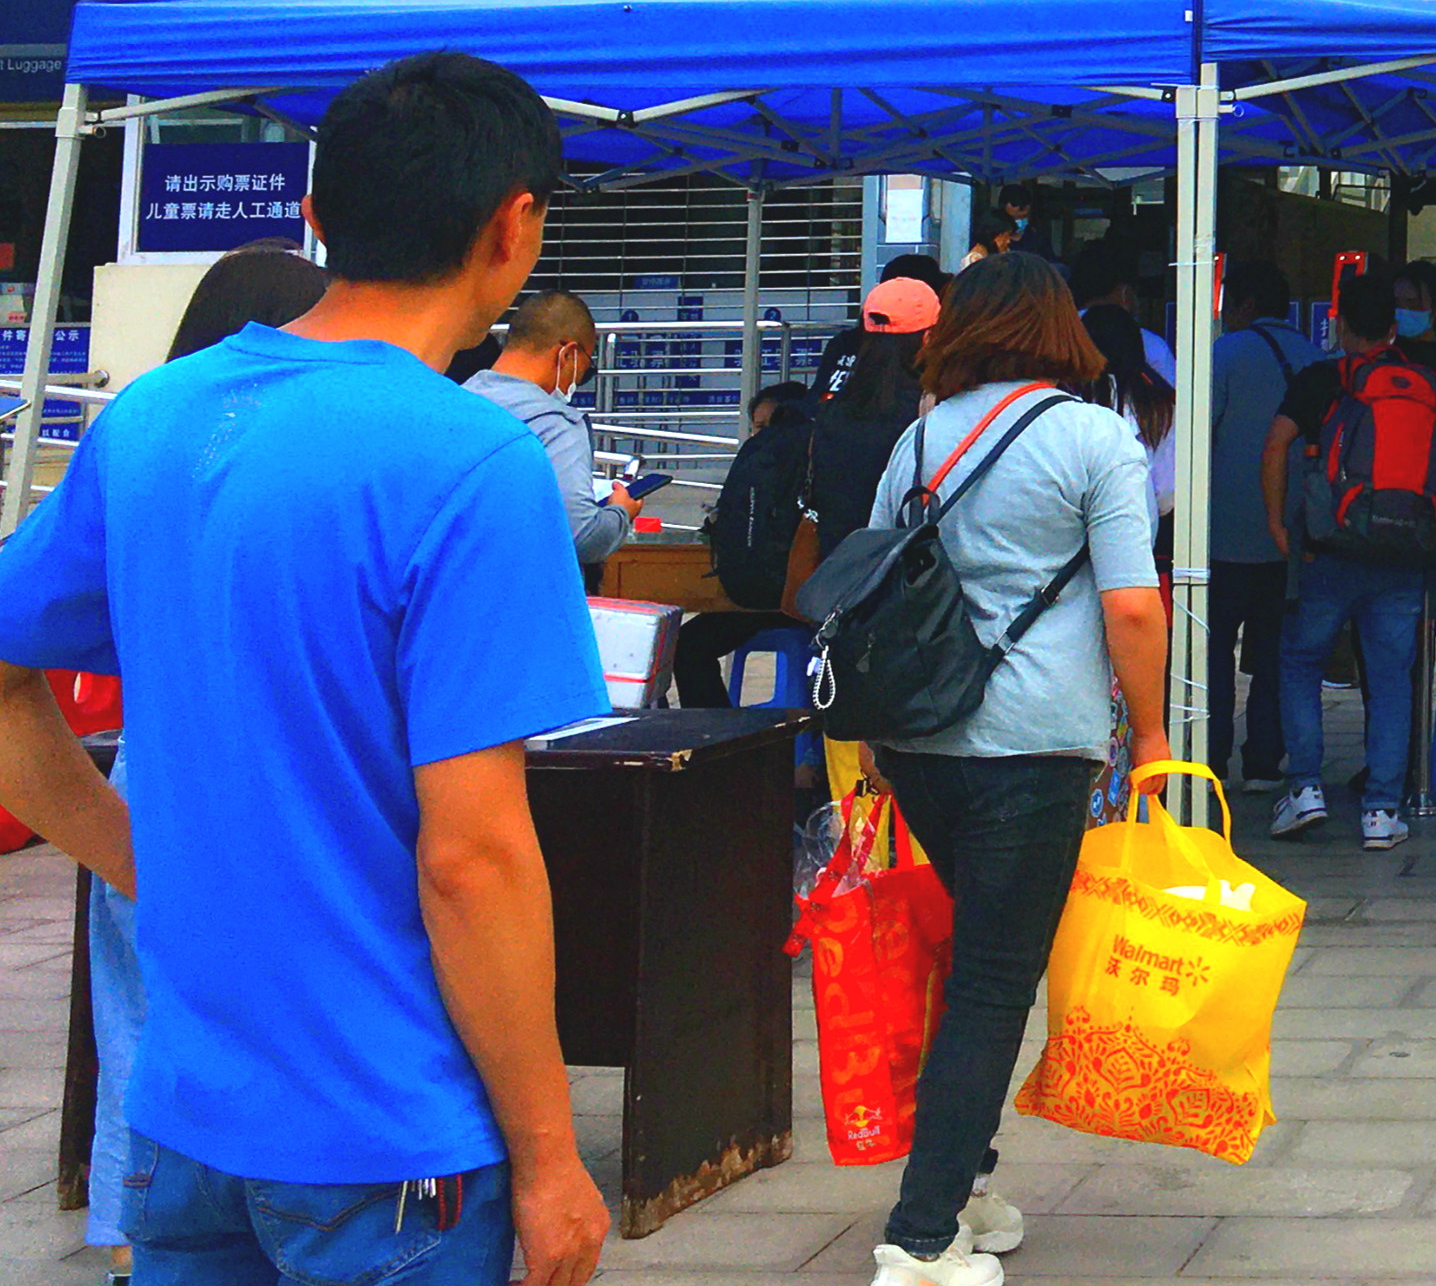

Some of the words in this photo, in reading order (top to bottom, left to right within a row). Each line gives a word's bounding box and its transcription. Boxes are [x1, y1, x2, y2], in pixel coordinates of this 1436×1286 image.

[7, 59, 62, 73] Luggage
[164, 173, 286, 192] 请出示购票证件
[145, 201, 302, 220] 儿童票请走人工通道
[1112, 933, 1185, 977] Walmart
[1105, 955, 1181, 997] 沃尔玛
